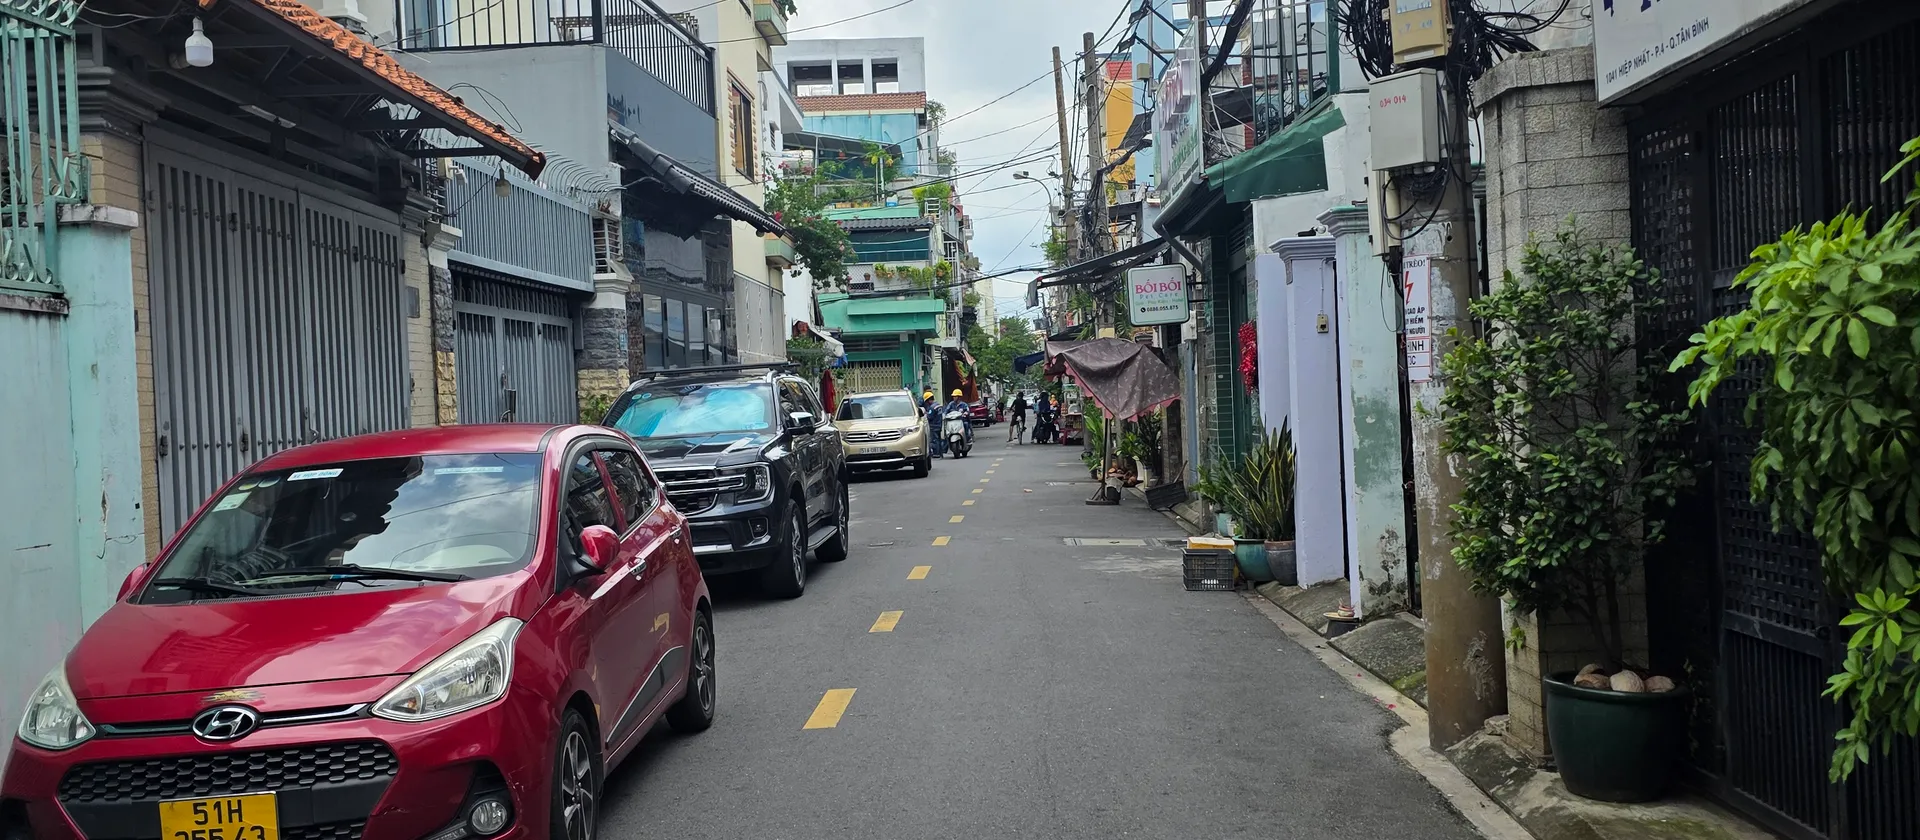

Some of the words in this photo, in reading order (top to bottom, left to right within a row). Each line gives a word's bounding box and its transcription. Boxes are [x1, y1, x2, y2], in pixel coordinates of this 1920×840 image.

[1605, 68, 1618, 84] 1041
[1618, 59, 1633, 77] HIỆP
[1633, 48, 1650, 69] NHẤT
[1654, 43, 1665, 58] P.4
[1669, 27, 1691, 49] Q.TÂN
[1691, 17, 1710, 38] BÌNH
[1135, 279, 1157, 294] BỐI
[1159, 277, 1181, 291] BỐI
[192, 799, 244, 825] 51H
